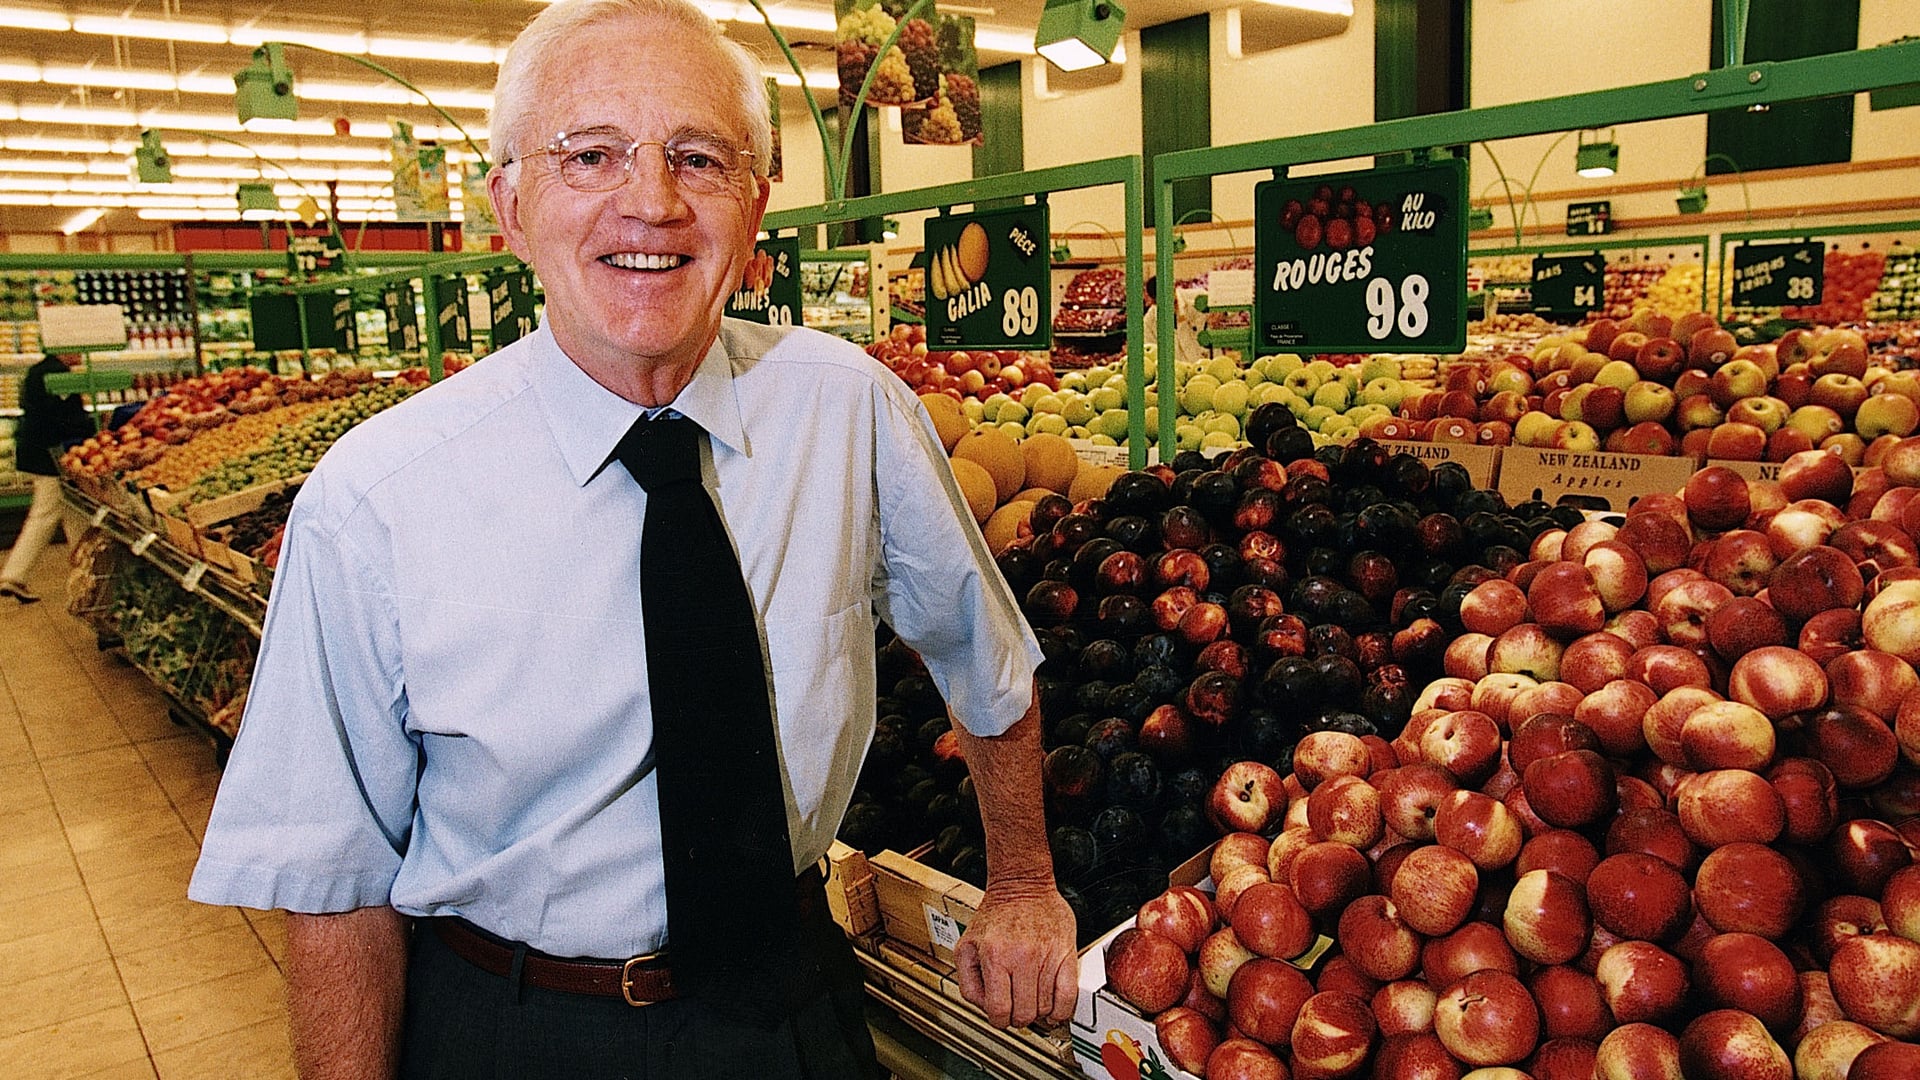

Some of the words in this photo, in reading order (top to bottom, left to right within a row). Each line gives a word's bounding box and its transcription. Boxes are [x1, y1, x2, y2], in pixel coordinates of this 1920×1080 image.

[1402, 193, 1424, 213] AU
[1401, 211, 1435, 231] KILO
[1009, 227, 1036, 256] PIÈCE
[1273, 246, 1374, 291] ROUGES
[732, 287, 770, 311] JAUNES
[947, 281, 992, 322] GALIA
[1365, 274, 1430, 340] 98
[1002, 286, 1039, 338] 89
[1394, 445, 1450, 459] ZEALAND
[1538, 453, 1568, 466] NEW
[1572, 454, 1641, 471] ZEALAND
[1552, 473, 1622, 488] Apples
